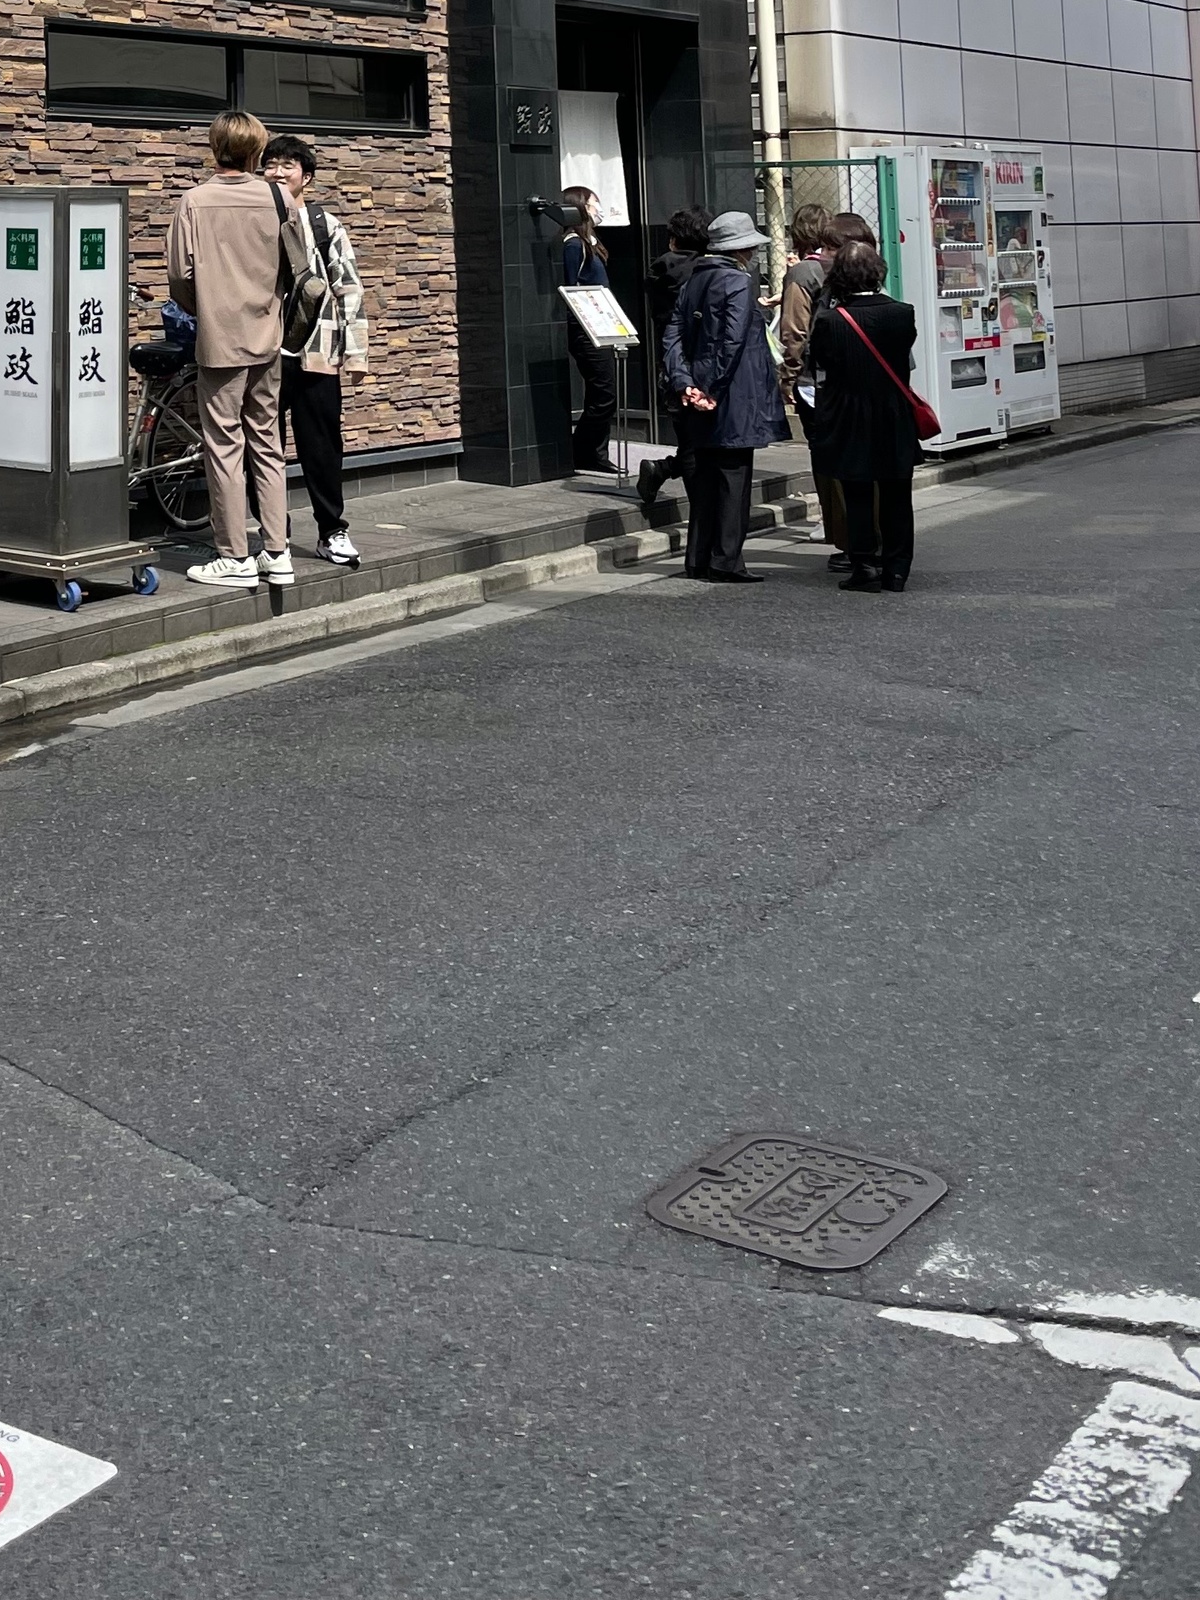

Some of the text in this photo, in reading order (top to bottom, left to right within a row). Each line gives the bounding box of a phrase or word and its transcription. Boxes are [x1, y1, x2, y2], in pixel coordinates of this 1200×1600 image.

[995, 161, 1024, 185] KIRIN
[4, 296, 39, 385] 鮨政
[78, 296, 106, 384] 鮨政
